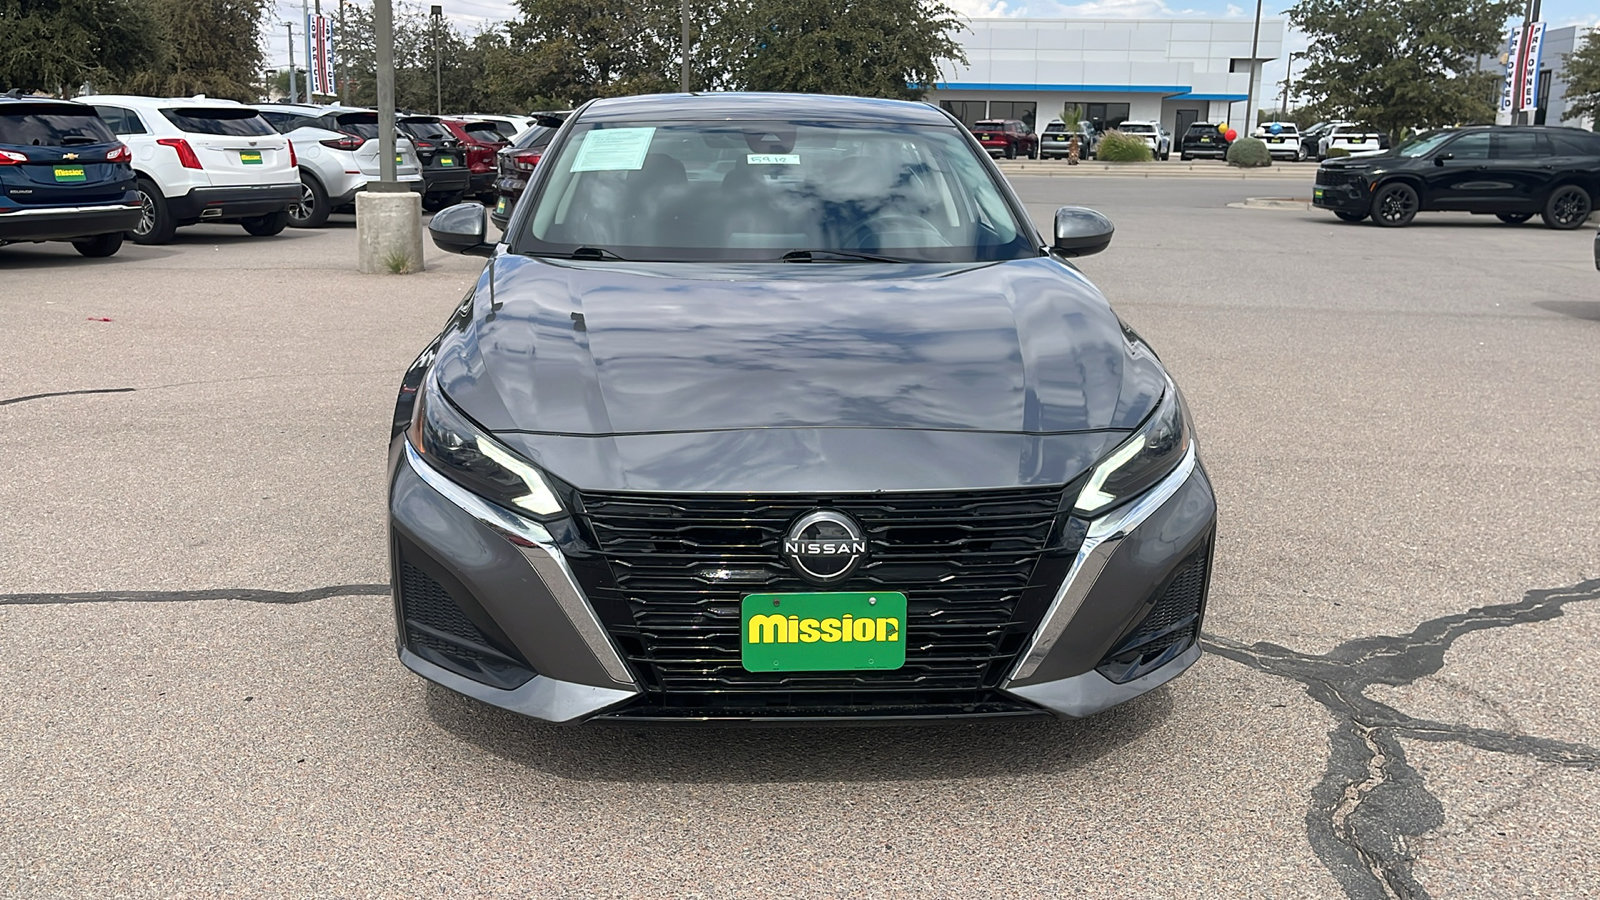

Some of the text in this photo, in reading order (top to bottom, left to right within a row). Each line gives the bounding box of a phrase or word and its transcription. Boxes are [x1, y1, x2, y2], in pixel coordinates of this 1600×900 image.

[1504, 31, 1521, 107] PRE OWNED
[1525, 27, 1541, 106] PRE OWNED
[785, 542, 866, 554] NISSAN
[748, 613, 900, 644] Mission
